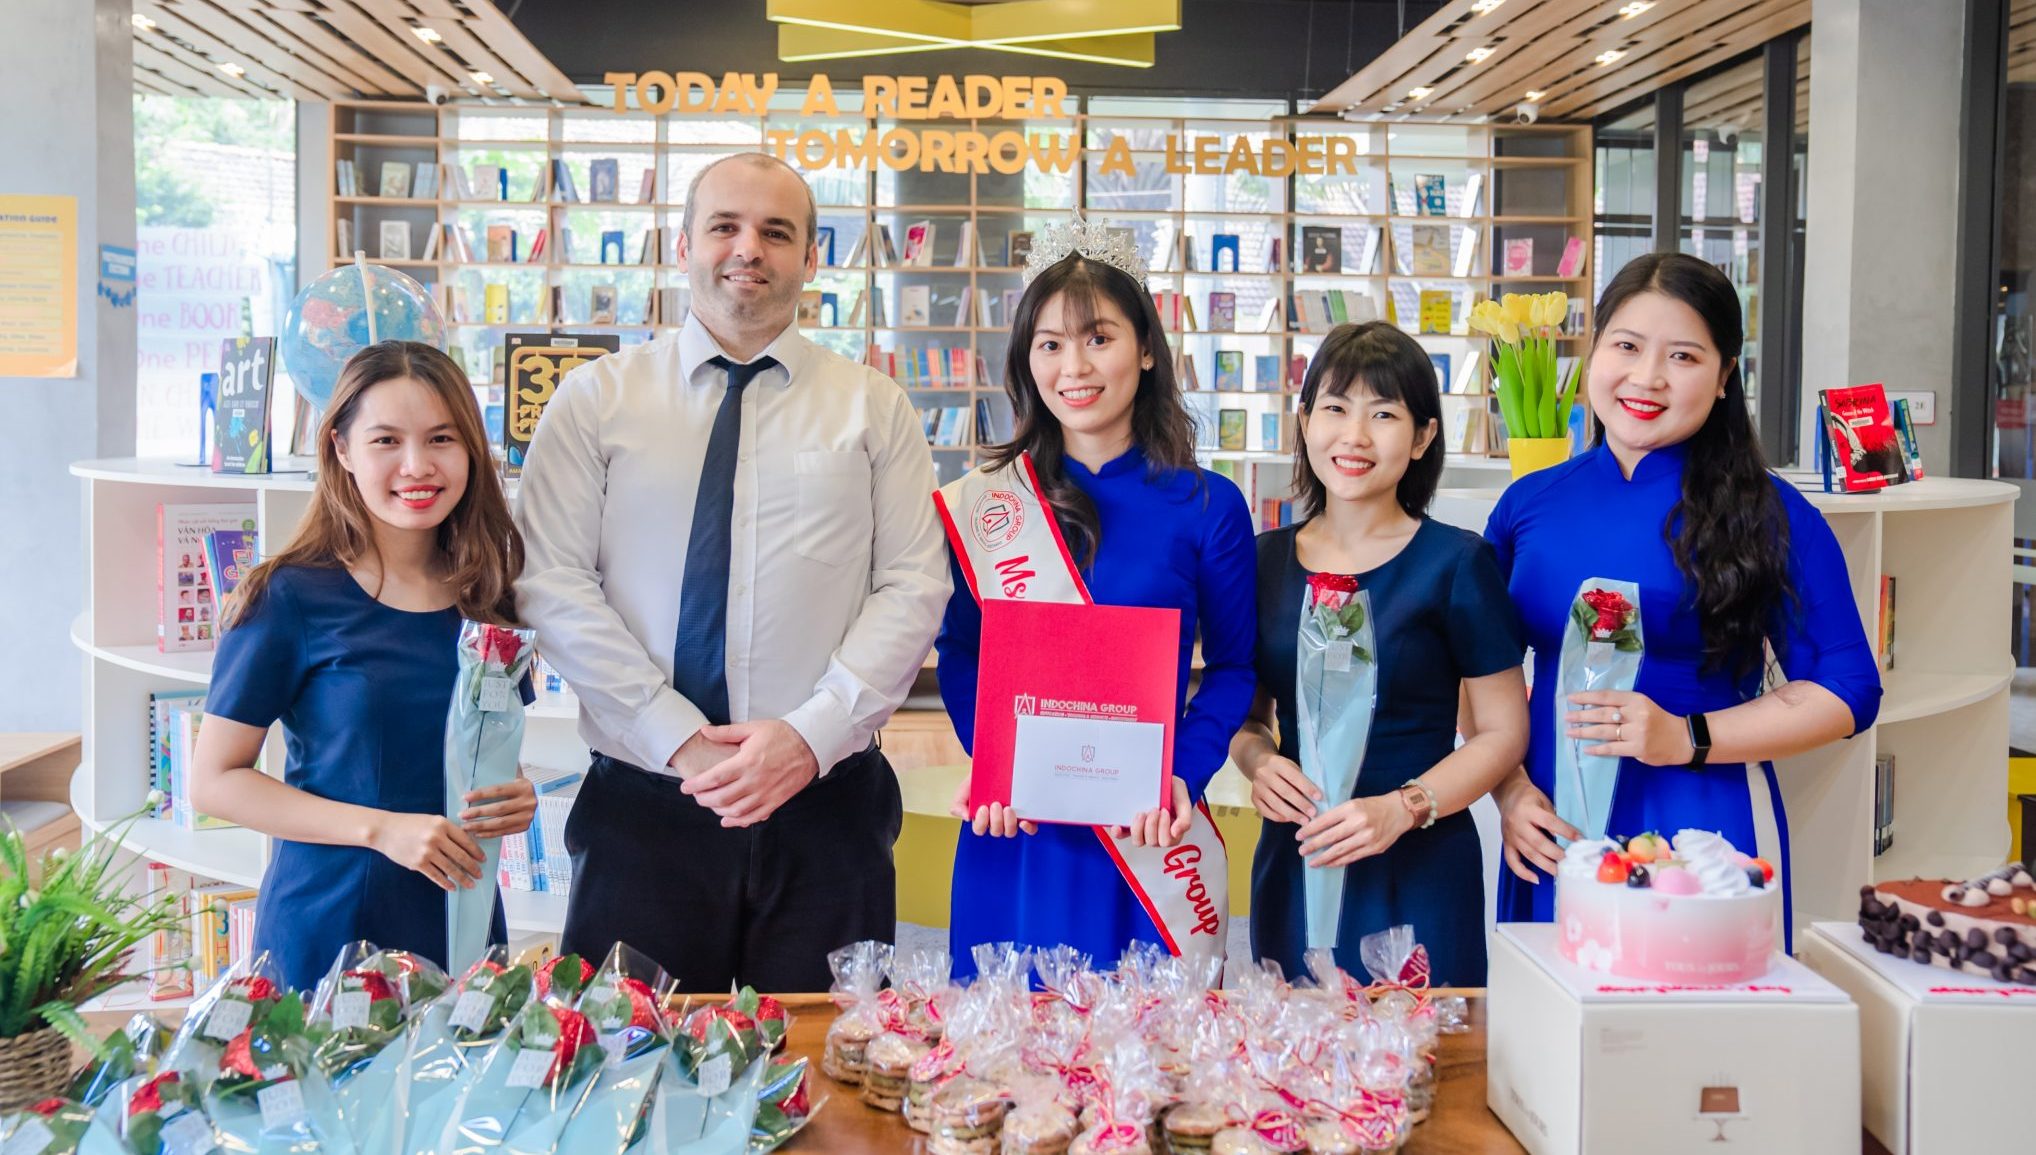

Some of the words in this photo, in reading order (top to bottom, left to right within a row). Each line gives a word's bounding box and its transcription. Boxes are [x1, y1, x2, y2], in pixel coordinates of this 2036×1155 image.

[604, 71, 779, 116] TODAY
[801, 74, 840, 117] A
[862, 75, 1068, 119] READER
[767, 128, 1083, 176] TOMORROW
[1099, 136, 1136, 177] A
[1165, 134, 1359, 177] LEADER
[222, 348, 265, 397] art
[992, 492, 1021, 512] INDOCHINA
[1006, 514, 1022, 541] GROUP
[994, 555, 1036, 599] Ms
[1040, 698, 1098, 712] INDOCHINA
[1100, 703, 1138, 715] GROUP
[1054, 764, 1093, 774] INDOCHINA
[1163, 844, 1220, 936] Group
